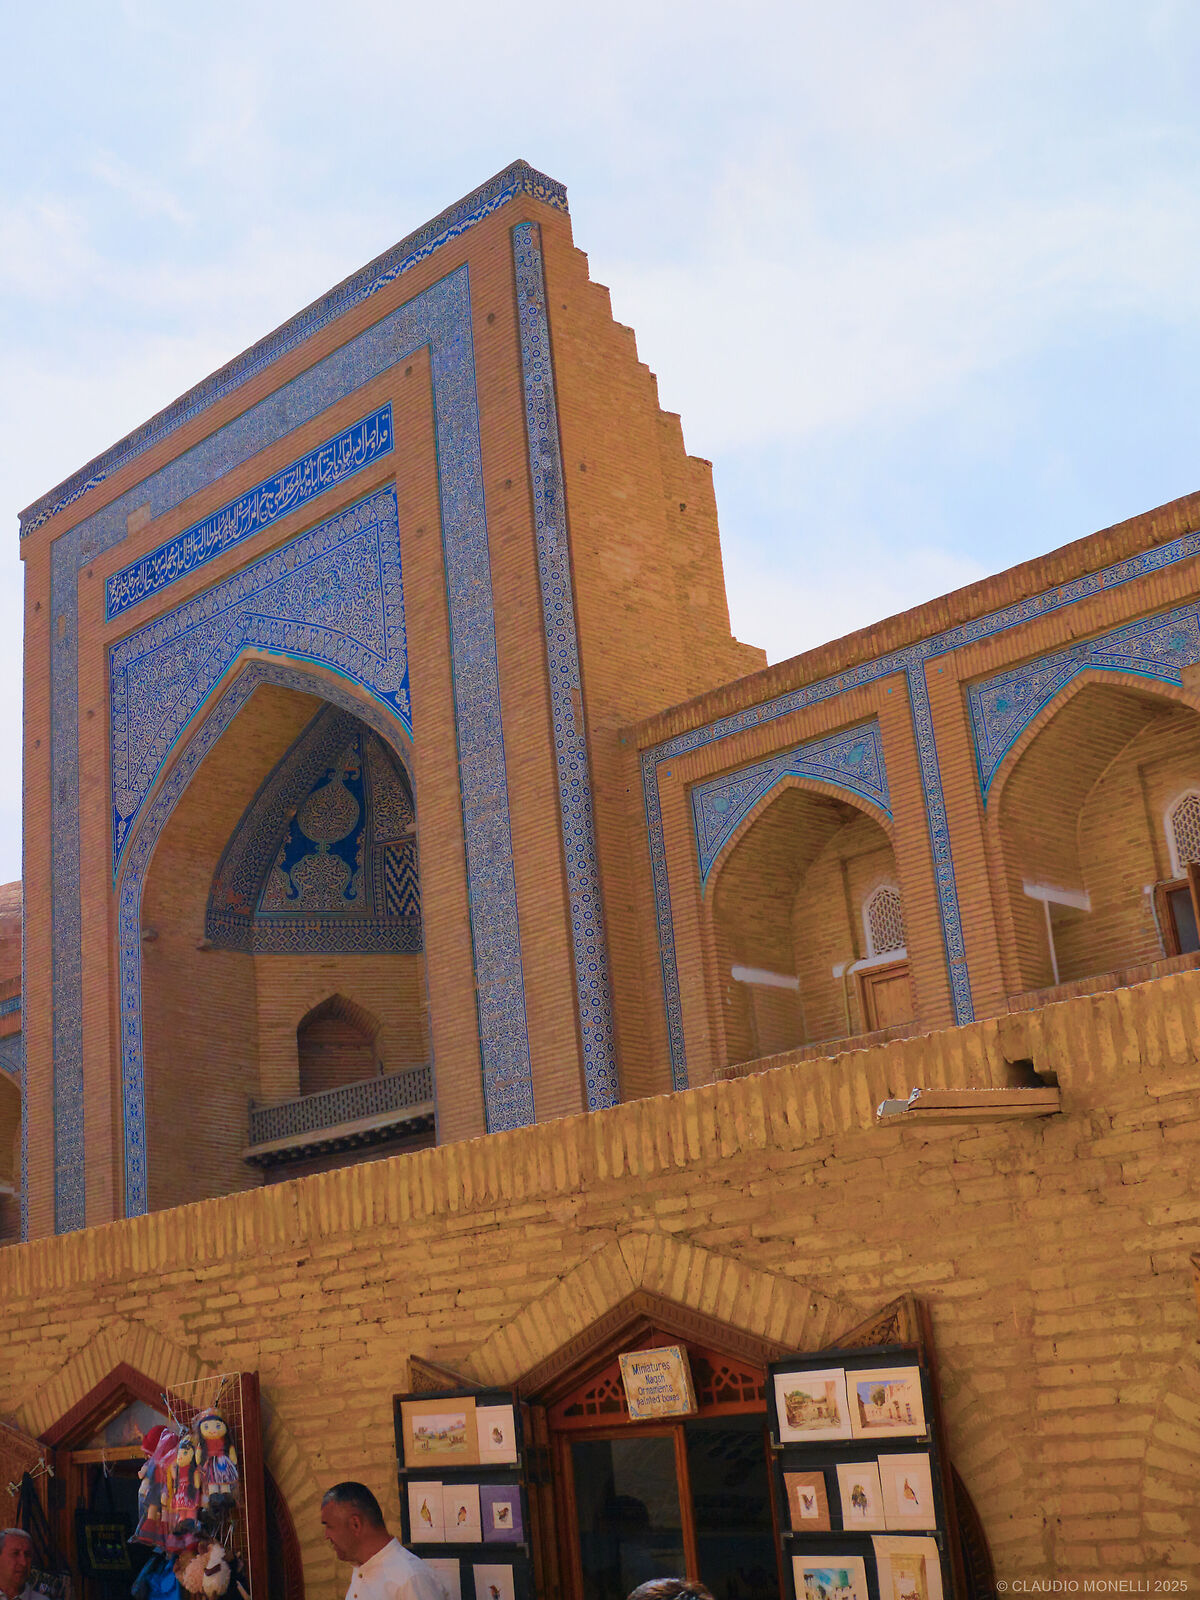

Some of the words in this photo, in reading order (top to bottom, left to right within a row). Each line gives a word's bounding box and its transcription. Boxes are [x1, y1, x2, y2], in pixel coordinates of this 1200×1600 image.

[632, 1361, 671, 1375] Miniatures
[645, 1373, 665, 1385] Naqsh
[638, 1384, 673, 1395] Ornaments
[636, 1395, 661, 1408] painted
[662, 1394, 680, 1403] boxes
